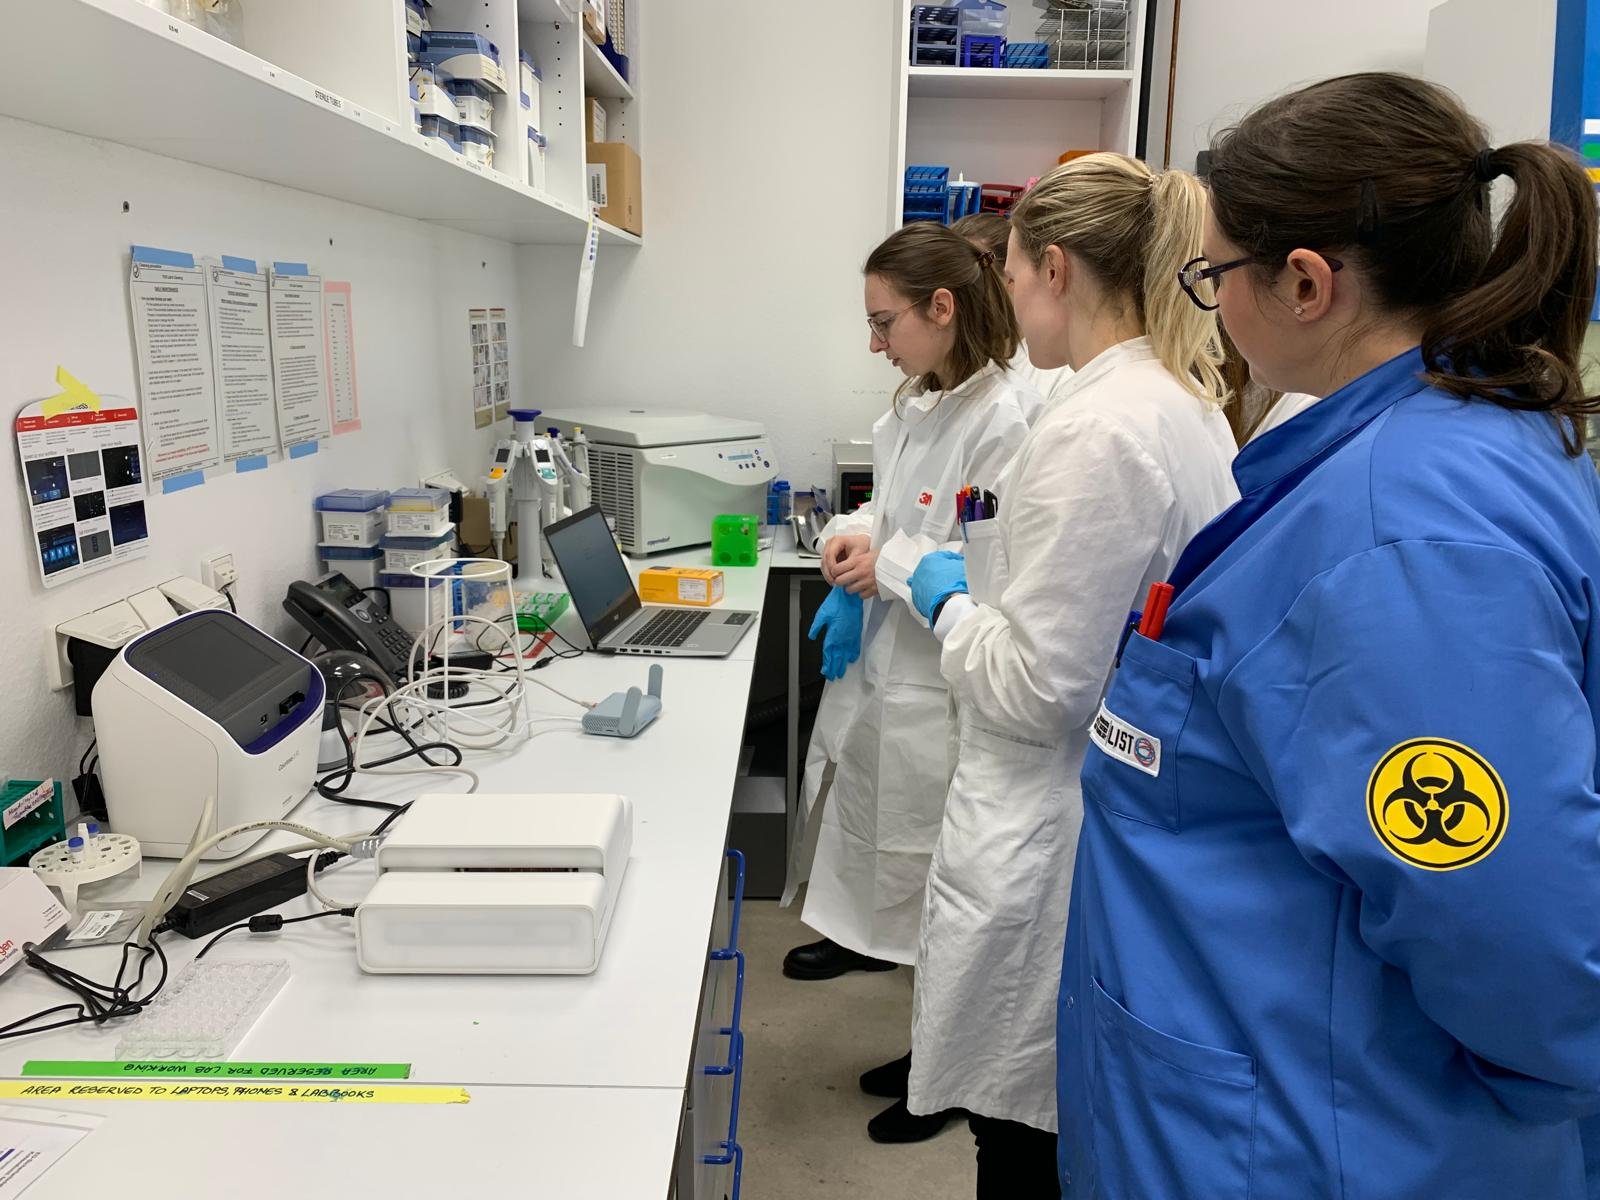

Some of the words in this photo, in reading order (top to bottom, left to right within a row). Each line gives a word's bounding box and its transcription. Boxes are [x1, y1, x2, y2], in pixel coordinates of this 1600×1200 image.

[1107, 725, 1135, 755] LIST
[123, 1063, 187, 1073] WORKING
[194, 1065, 222, 1074] LAB
[227, 1067, 253, 1075] FOR
[260, 1067, 334, 1076] RESERVED
[341, 1067, 378, 1076] AREA
[20, 1085, 62, 1095] AREA
[68, 1085, 143, 1095] RESERVED
[149, 1086, 167, 1095] TO
